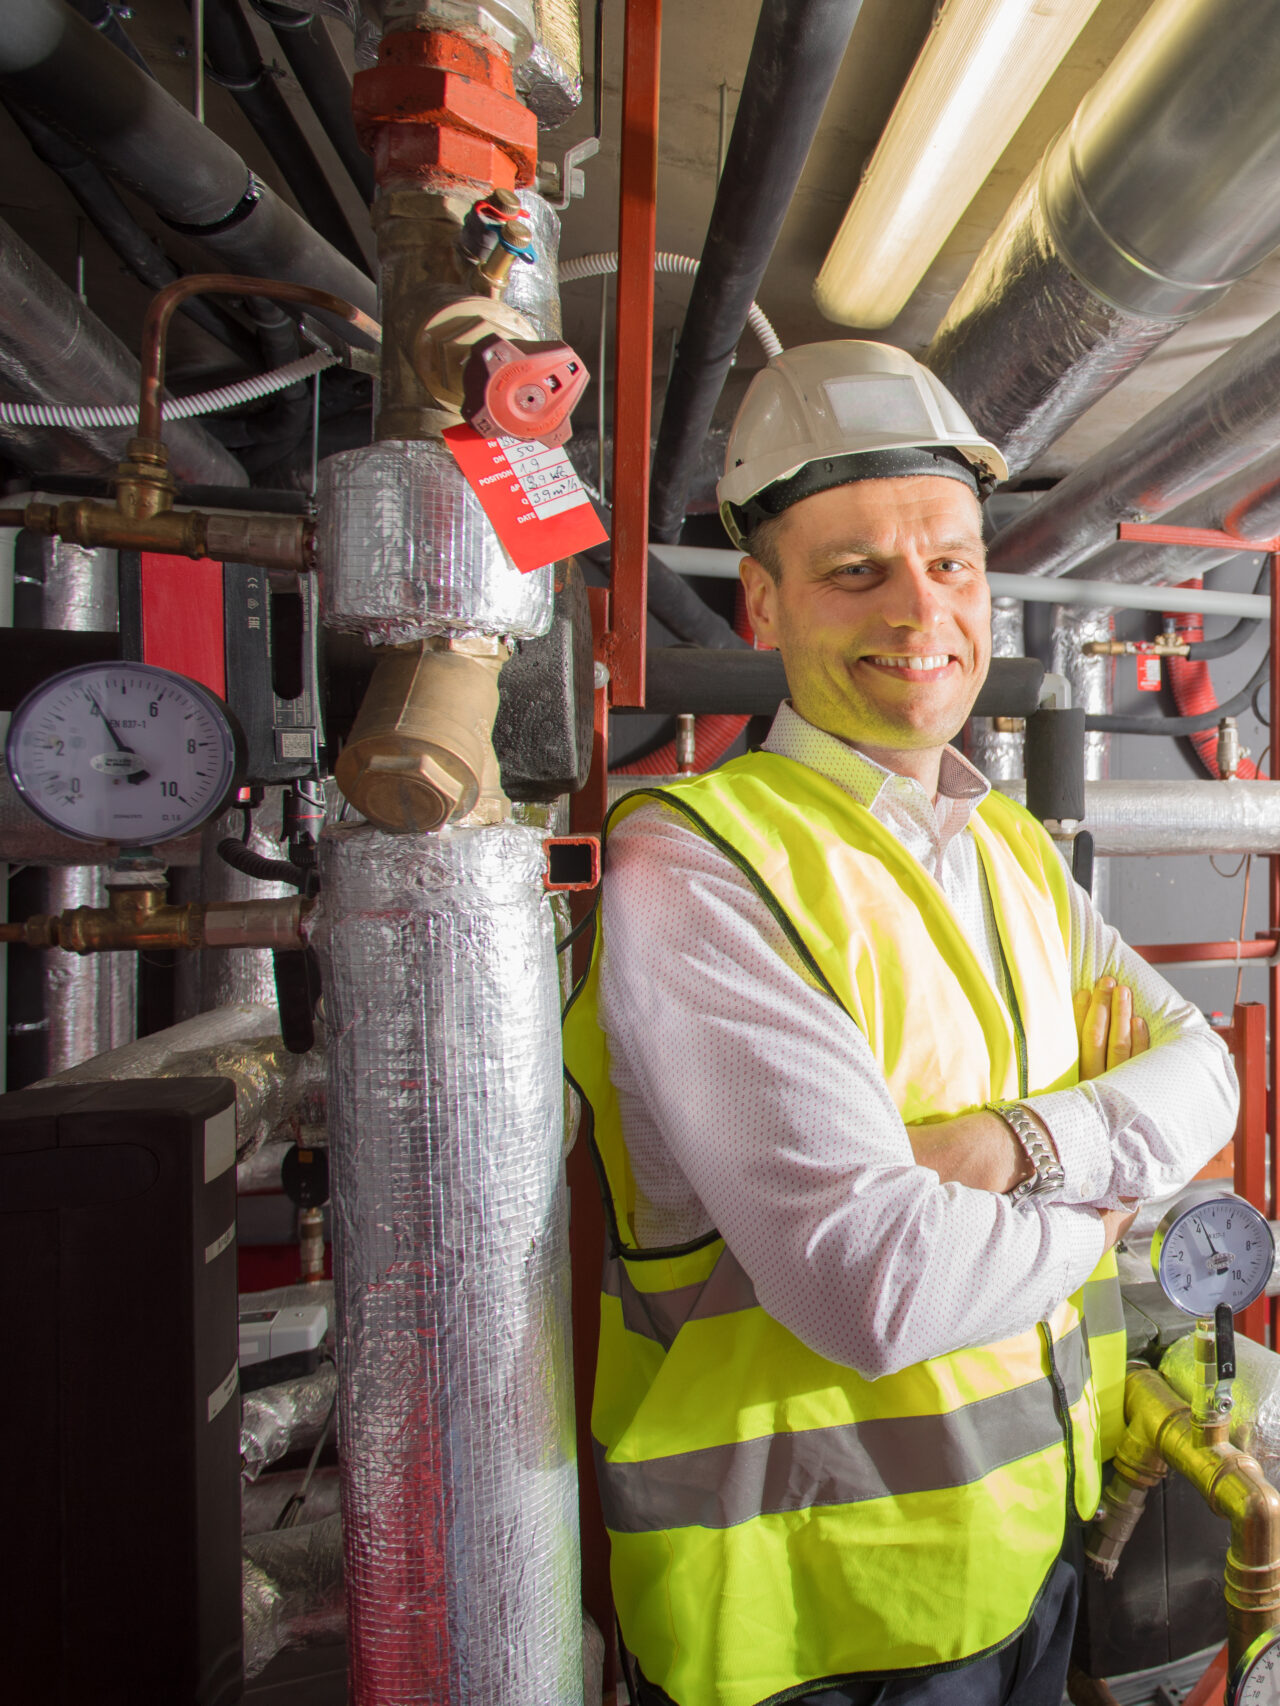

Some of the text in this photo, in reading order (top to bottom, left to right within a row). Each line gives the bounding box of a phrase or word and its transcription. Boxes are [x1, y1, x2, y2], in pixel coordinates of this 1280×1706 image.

[487, 440, 498, 448] Nr
[516, 445, 535, 457] 50
[493, 455, 506, 464] DN
[478, 469, 513, 486] POSITION
[516, 512, 536, 524] DATE
[90, 703, 100, 718] 4
[150, 702, 159, 718] 6
[122, 719, 147, 729] 837-1
[56, 741, 65, 756] 2
[187, 739, 196, 755] 8
[71, 778, 80, 794] 0
[161, 781, 178, 798] 10
[1196, 1224, 1201, 1233] 4
[1226, 1219, 1232, 1230] 6
[1246, 1242, 1251, 1251] 8
[1178, 1251, 1184, 1261] 2
[1186, 1274, 1192, 1284] 0
[1232, 1269, 1242, 1280] 10
[1265, 1661, 1274, 1670] 30
[1256, 1675, 1265, 1683] 20
[1252, 1690, 1261, 1698] 10
